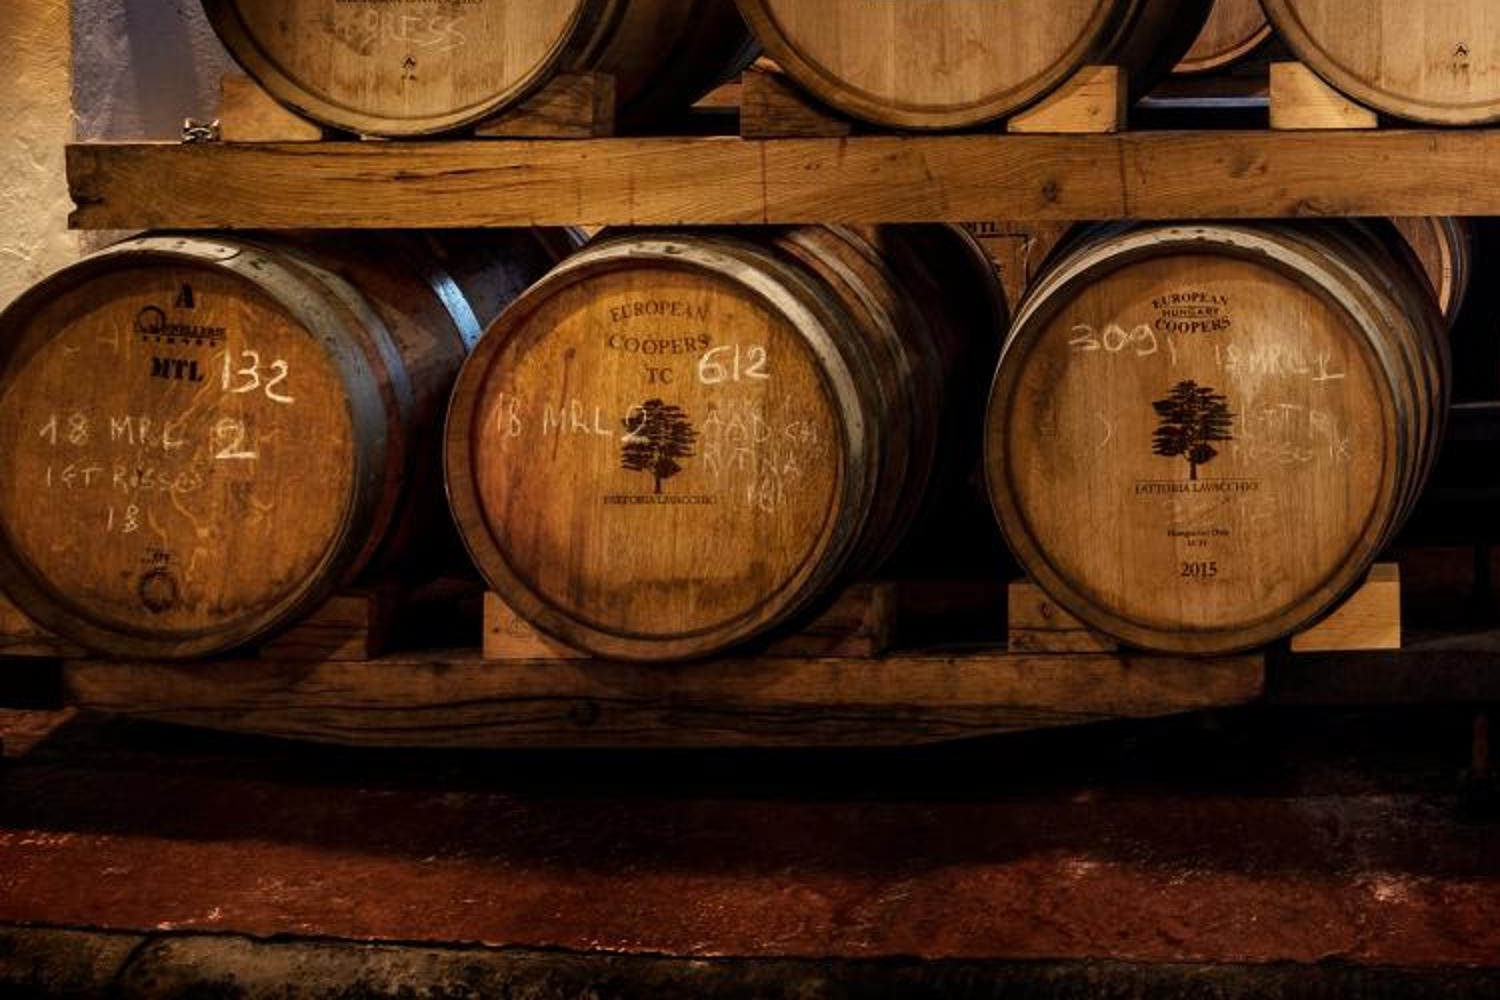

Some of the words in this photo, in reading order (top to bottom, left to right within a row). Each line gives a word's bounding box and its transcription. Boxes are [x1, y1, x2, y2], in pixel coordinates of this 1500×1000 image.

[609, 299, 708, 323] EUROPEAN
[1152, 291, 1229, 309] EUROPEAN
[1154, 317, 1232, 334] COOPERS
[607, 332, 711, 356] COOPERS
[151, 357, 204, 382] MTL
[646, 366, 674, 385] TC
[699, 343, 769, 385] 612
[221, 349, 295, 404] 132
[543, 397, 614, 436] MRL
[1180, 560, 1218, 578] 2015
